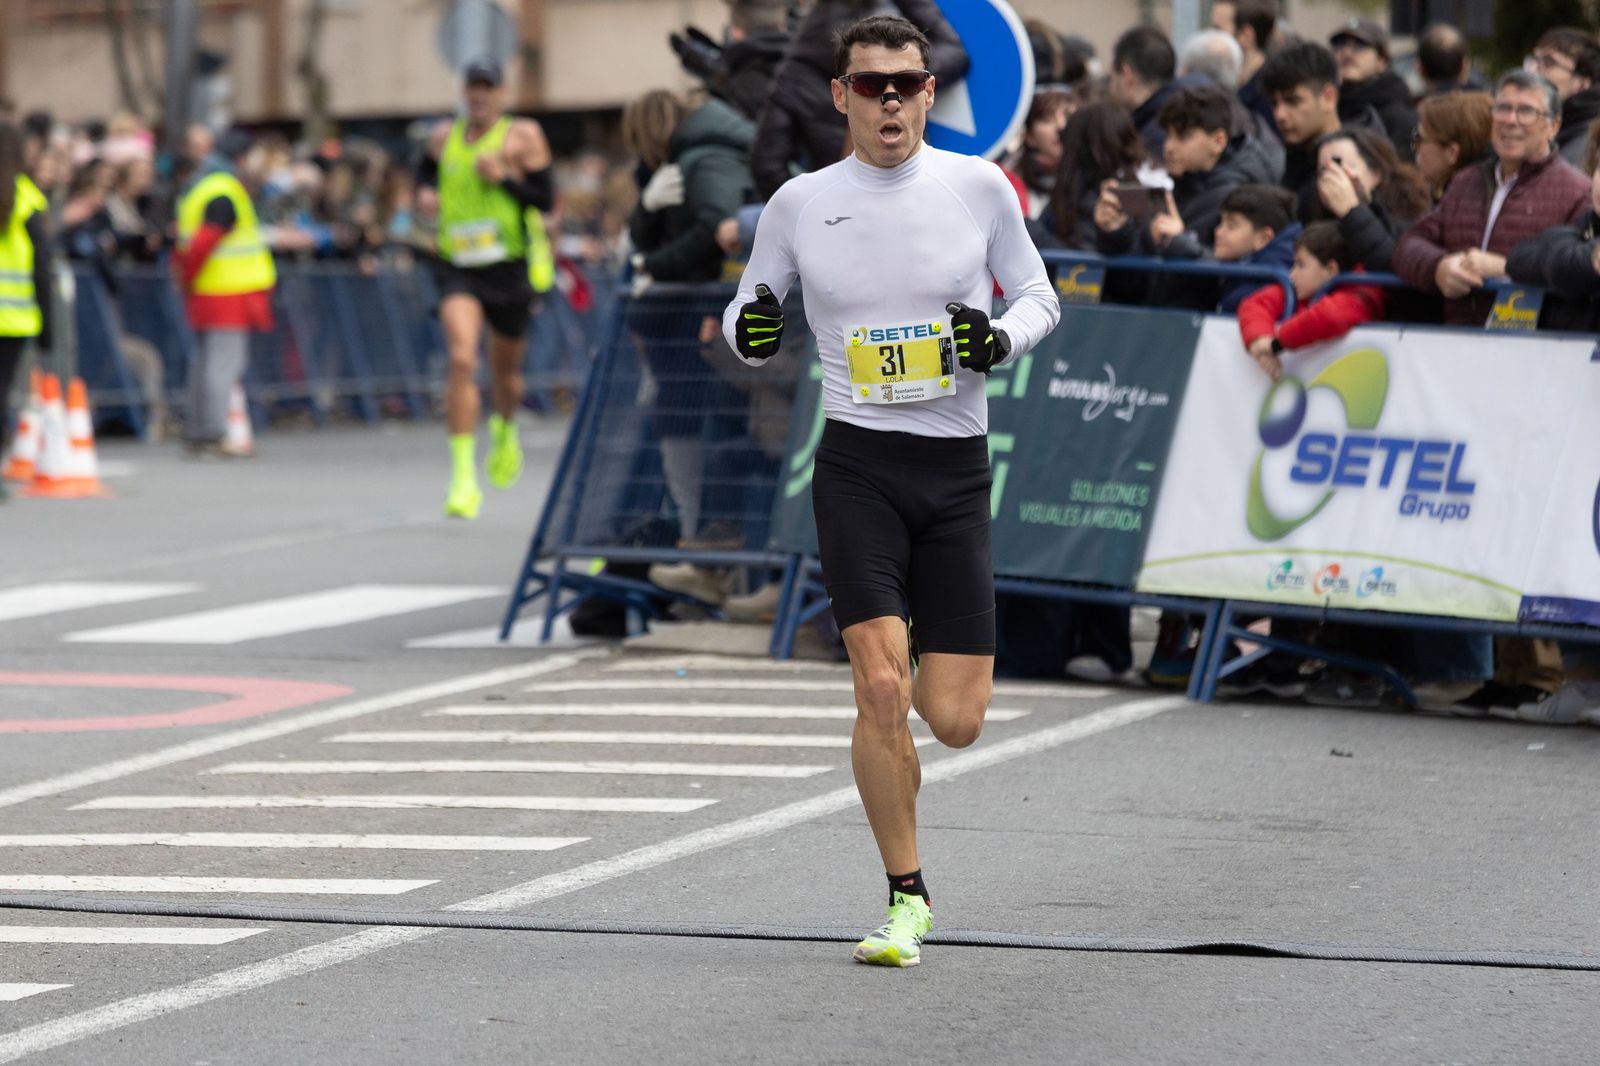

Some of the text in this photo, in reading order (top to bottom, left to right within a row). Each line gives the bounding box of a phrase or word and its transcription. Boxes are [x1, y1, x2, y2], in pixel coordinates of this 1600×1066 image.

[870, 323, 941, 342] SETEL
[879, 344, 906, 377] 31
[1290, 432, 1476, 494] SETEL
[1398, 494, 1471, 523] Grupo
